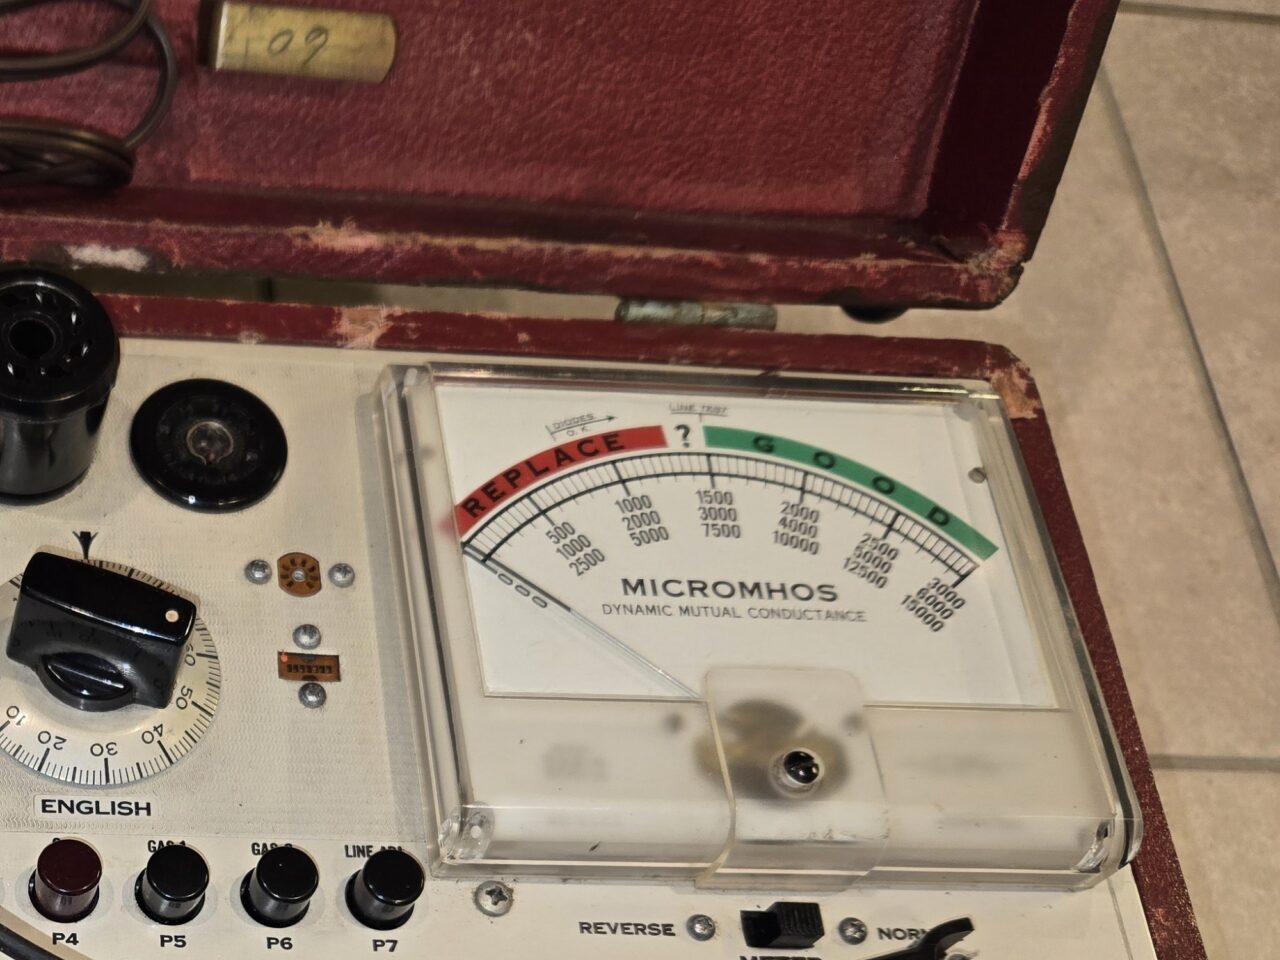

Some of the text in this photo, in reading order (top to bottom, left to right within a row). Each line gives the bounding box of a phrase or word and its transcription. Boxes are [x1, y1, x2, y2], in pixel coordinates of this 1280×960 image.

[675, 424, 691, 448] ?
[461, 433, 625, 518] REPLACE
[615, 495, 652, 514] 1000
[696, 490, 733, 505] 1500
[622, 511, 661, 531] 2000
[699, 507, 737, 522] 3000
[781, 502, 819, 522] 2000
[546, 522, 575, 545] 500
[630, 526, 669, 547] 5000
[701, 523, 741, 538] 7500
[778, 518, 818, 537] 4000
[556, 534, 591, 560] 1000
[773, 531, 819, 555] 10000
[858, 533, 899, 561] 2500
[569, 548, 605, 576] 2500
[842, 557, 888, 589] 12500
[621, 578, 838, 602] MICROMHOS
[927, 577, 966, 609] 3000
[603, 604, 867, 622] DYNAMIC MUTUAL CONDUCTANCE
[901, 594, 944, 632] 15000
[41, 799, 151, 816] ENGLISH
[52, 932, 79, 945] P4
[579, 921, 676, 937] REVERSE
[159, 935, 187, 948] P5
[266, 937, 293, 950] P6
[372, 939, 398, 952] P7
